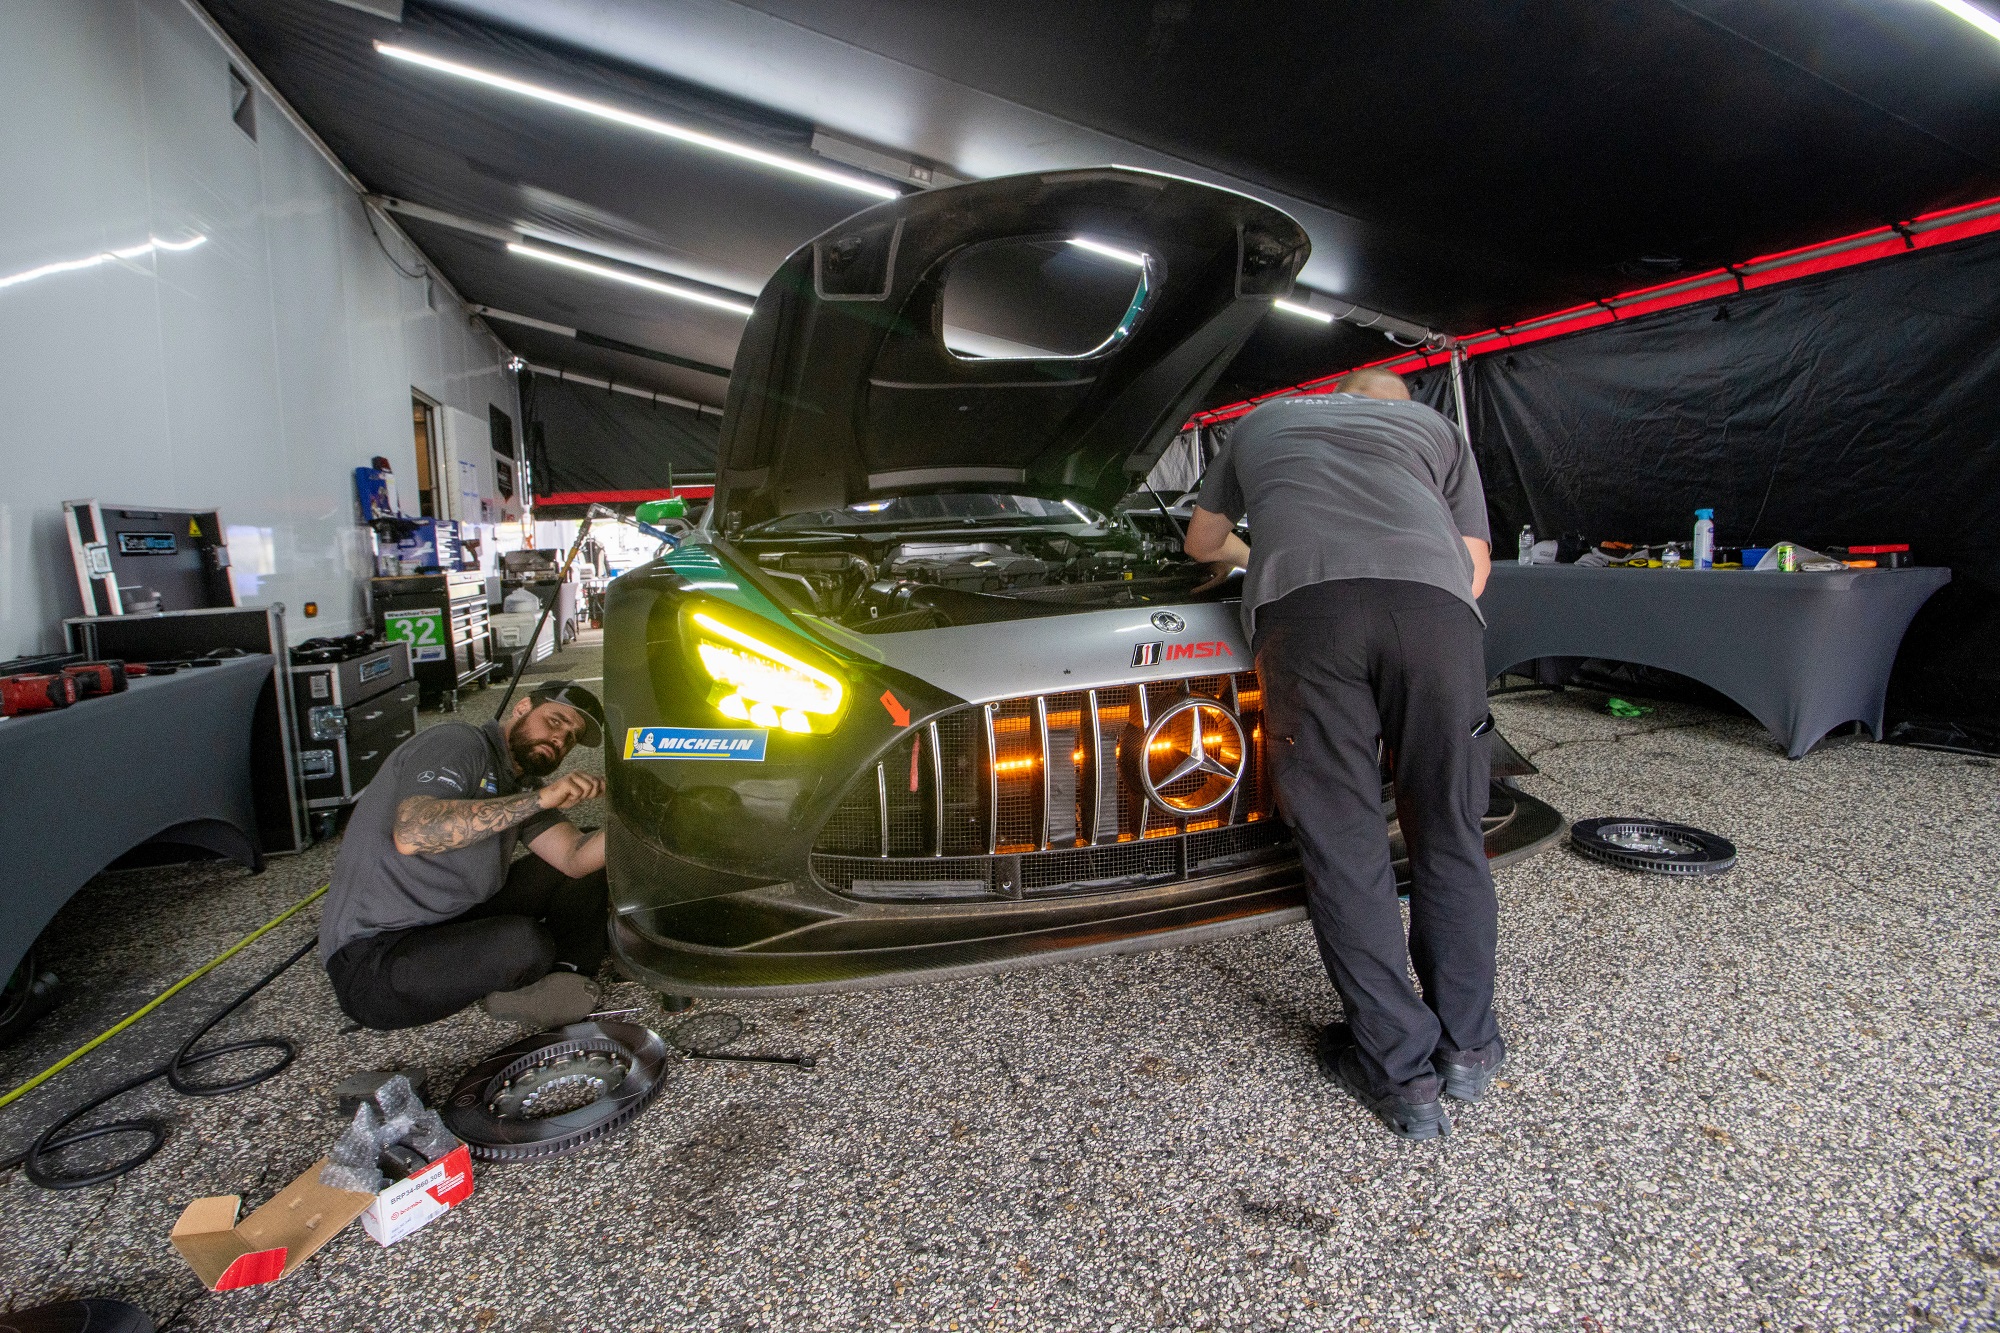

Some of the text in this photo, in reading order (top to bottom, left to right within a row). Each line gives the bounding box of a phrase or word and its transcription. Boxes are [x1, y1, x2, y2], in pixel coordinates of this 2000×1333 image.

[395, 617, 437, 645] 32
[1165, 641, 1233, 661] IMSA
[658, 737, 753, 750] MICHELIN
